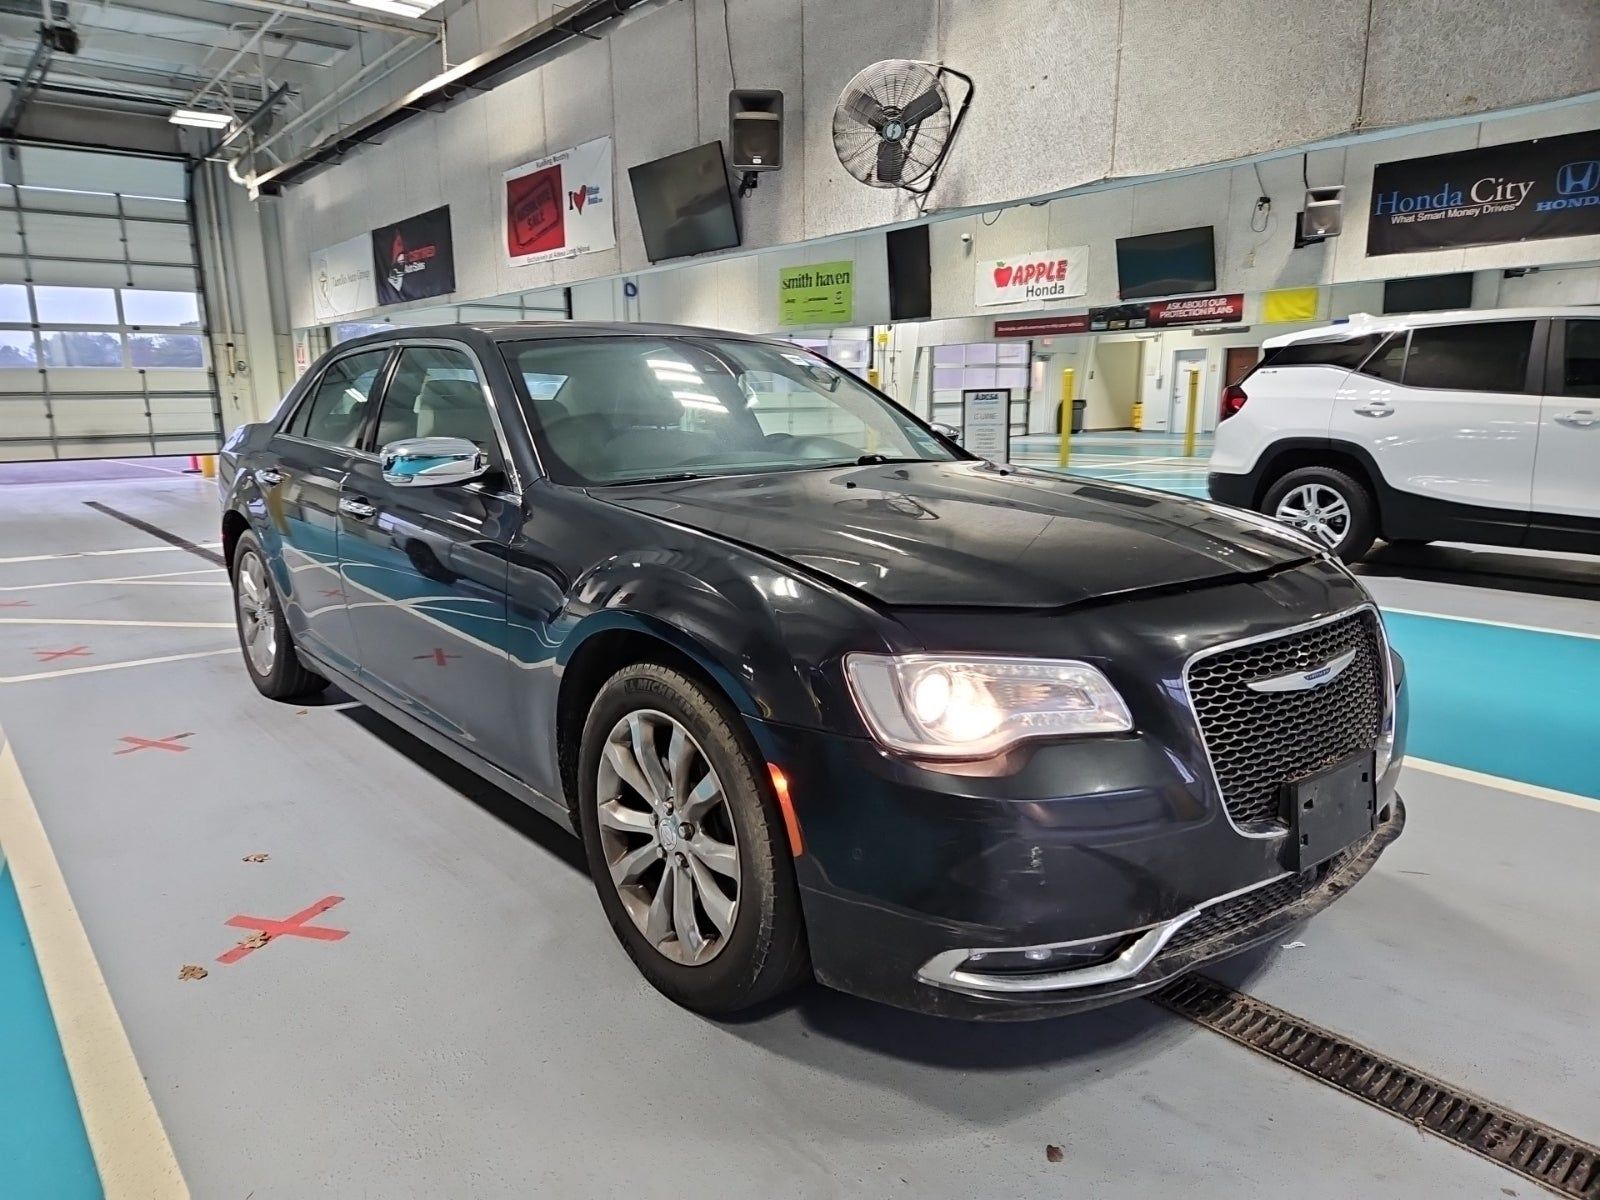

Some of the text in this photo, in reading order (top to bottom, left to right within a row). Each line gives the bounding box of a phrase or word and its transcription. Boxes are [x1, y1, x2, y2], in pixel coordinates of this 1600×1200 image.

[1375, 176, 1536, 216] Honda City
[1391, 203, 1516, 225] What Smart Money Drives
[782, 272, 850, 290] smith haven
[1012, 259, 1068, 287] APPLE
[1026, 282, 1065, 298] Honda
[1159, 305, 1234, 319] PROTECTION PLANS
[1182, 299, 1208, 308] ABOUT
[1208, 298, 1227, 306] OUR
